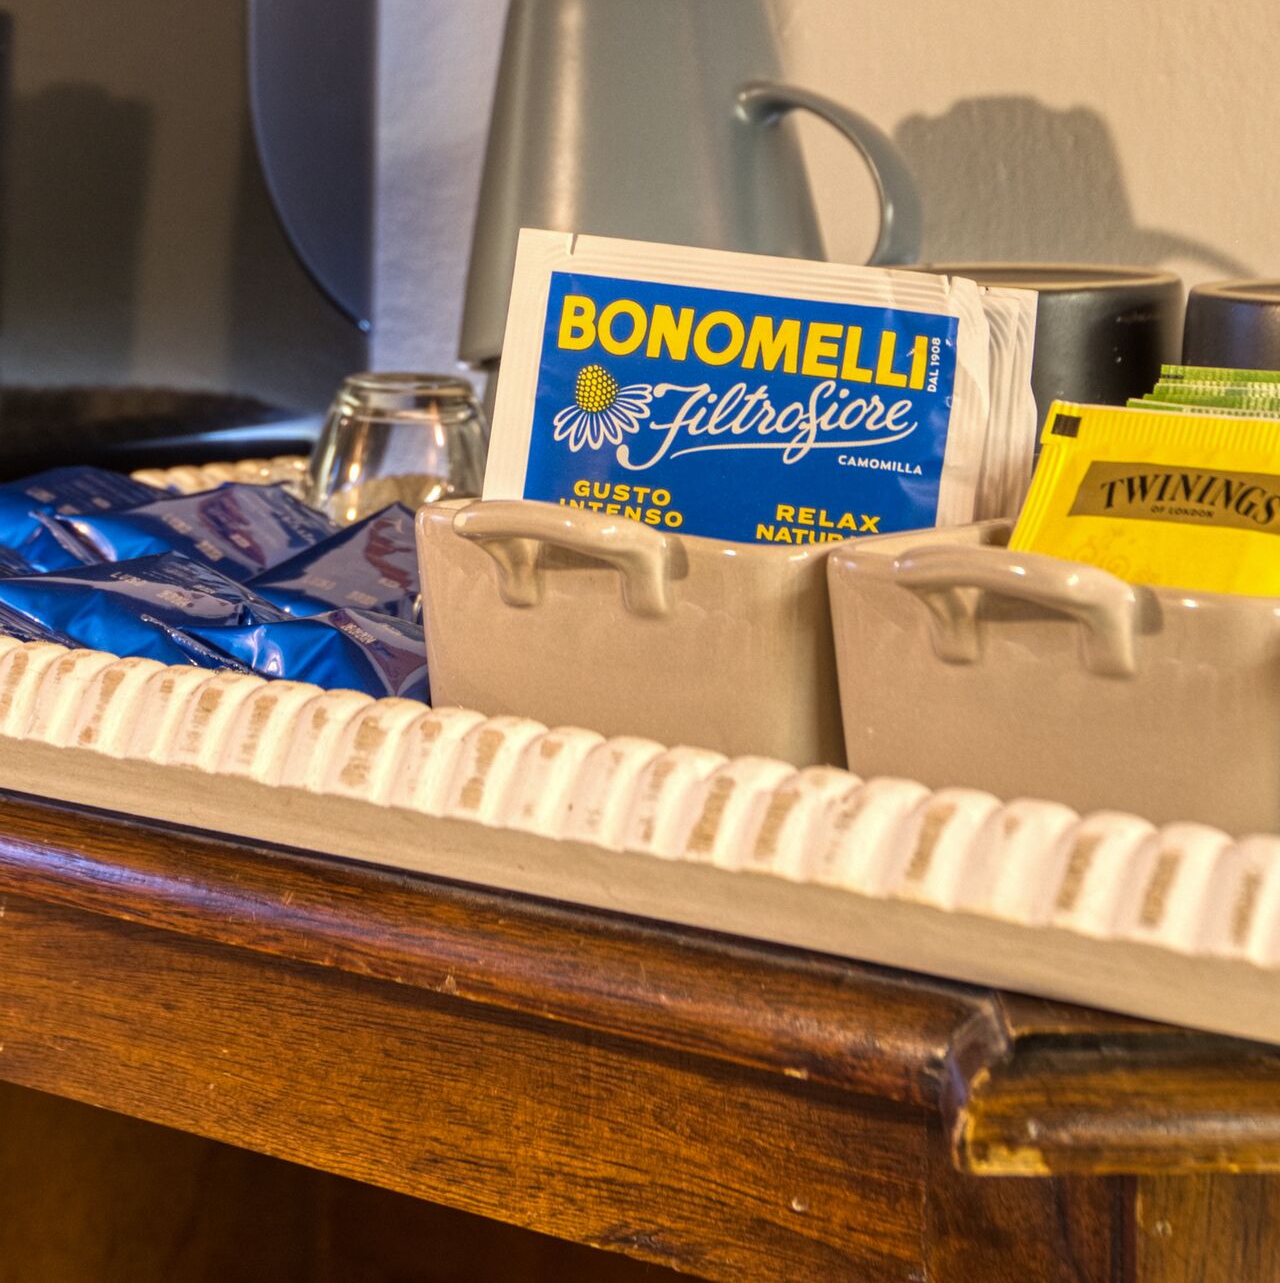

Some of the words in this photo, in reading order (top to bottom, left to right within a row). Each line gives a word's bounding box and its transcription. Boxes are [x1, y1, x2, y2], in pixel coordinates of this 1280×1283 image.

[557, 295, 929, 391] BONOMELLI
[929, 337, 942, 366] 1908
[928, 368, 940, 393] DAL
[616, 380, 917, 471] Filtrofiore
[838, 454, 923, 476] CAMOMILLA
[573, 480, 671, 507] GUSTO
[776, 504, 881, 534] RELAX
[1151, 505, 1165, 514] OF
[1168, 506, 1215, 519] LONDON
